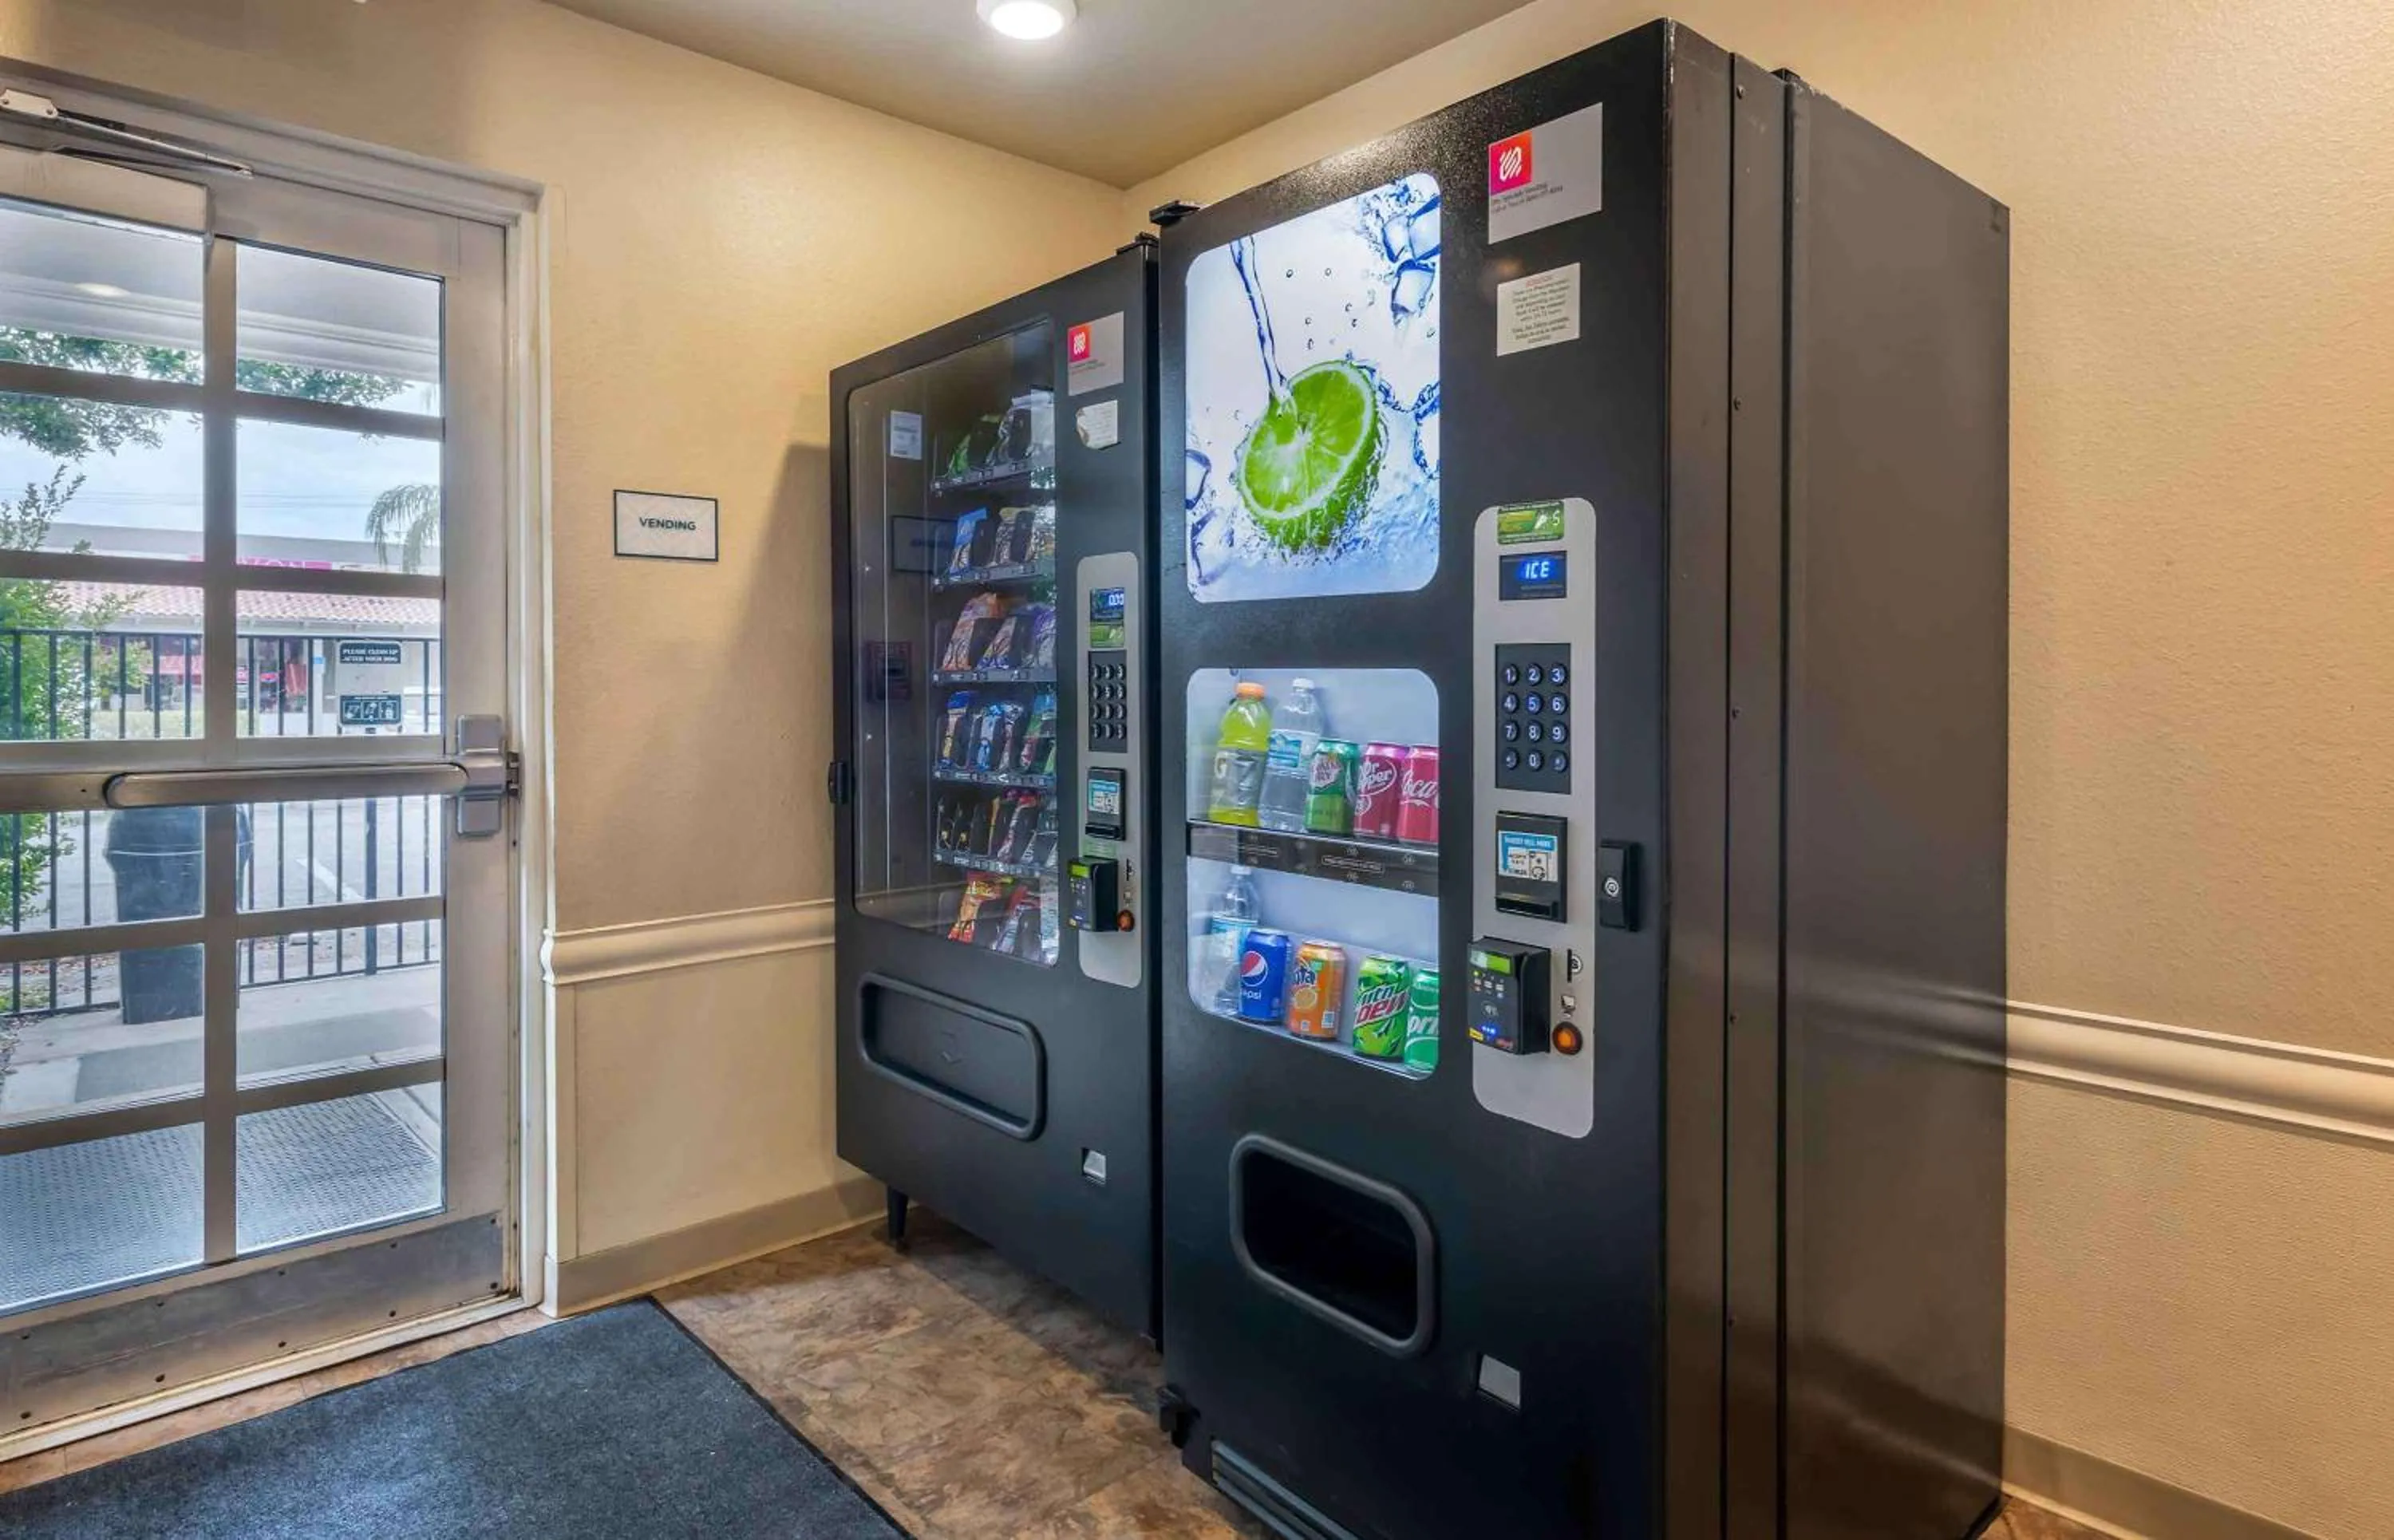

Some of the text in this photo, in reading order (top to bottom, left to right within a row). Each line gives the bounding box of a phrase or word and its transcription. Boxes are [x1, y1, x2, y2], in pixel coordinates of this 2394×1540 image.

[639, 516, 697, 531] VENDING
[1525, 561, 1550, 578] ICE
[1528, 668, 1538, 681] 2
[1551, 668, 1561, 682] 3
[1552, 725, 1561, 740] 9
[1215, 752, 1229, 779] G
